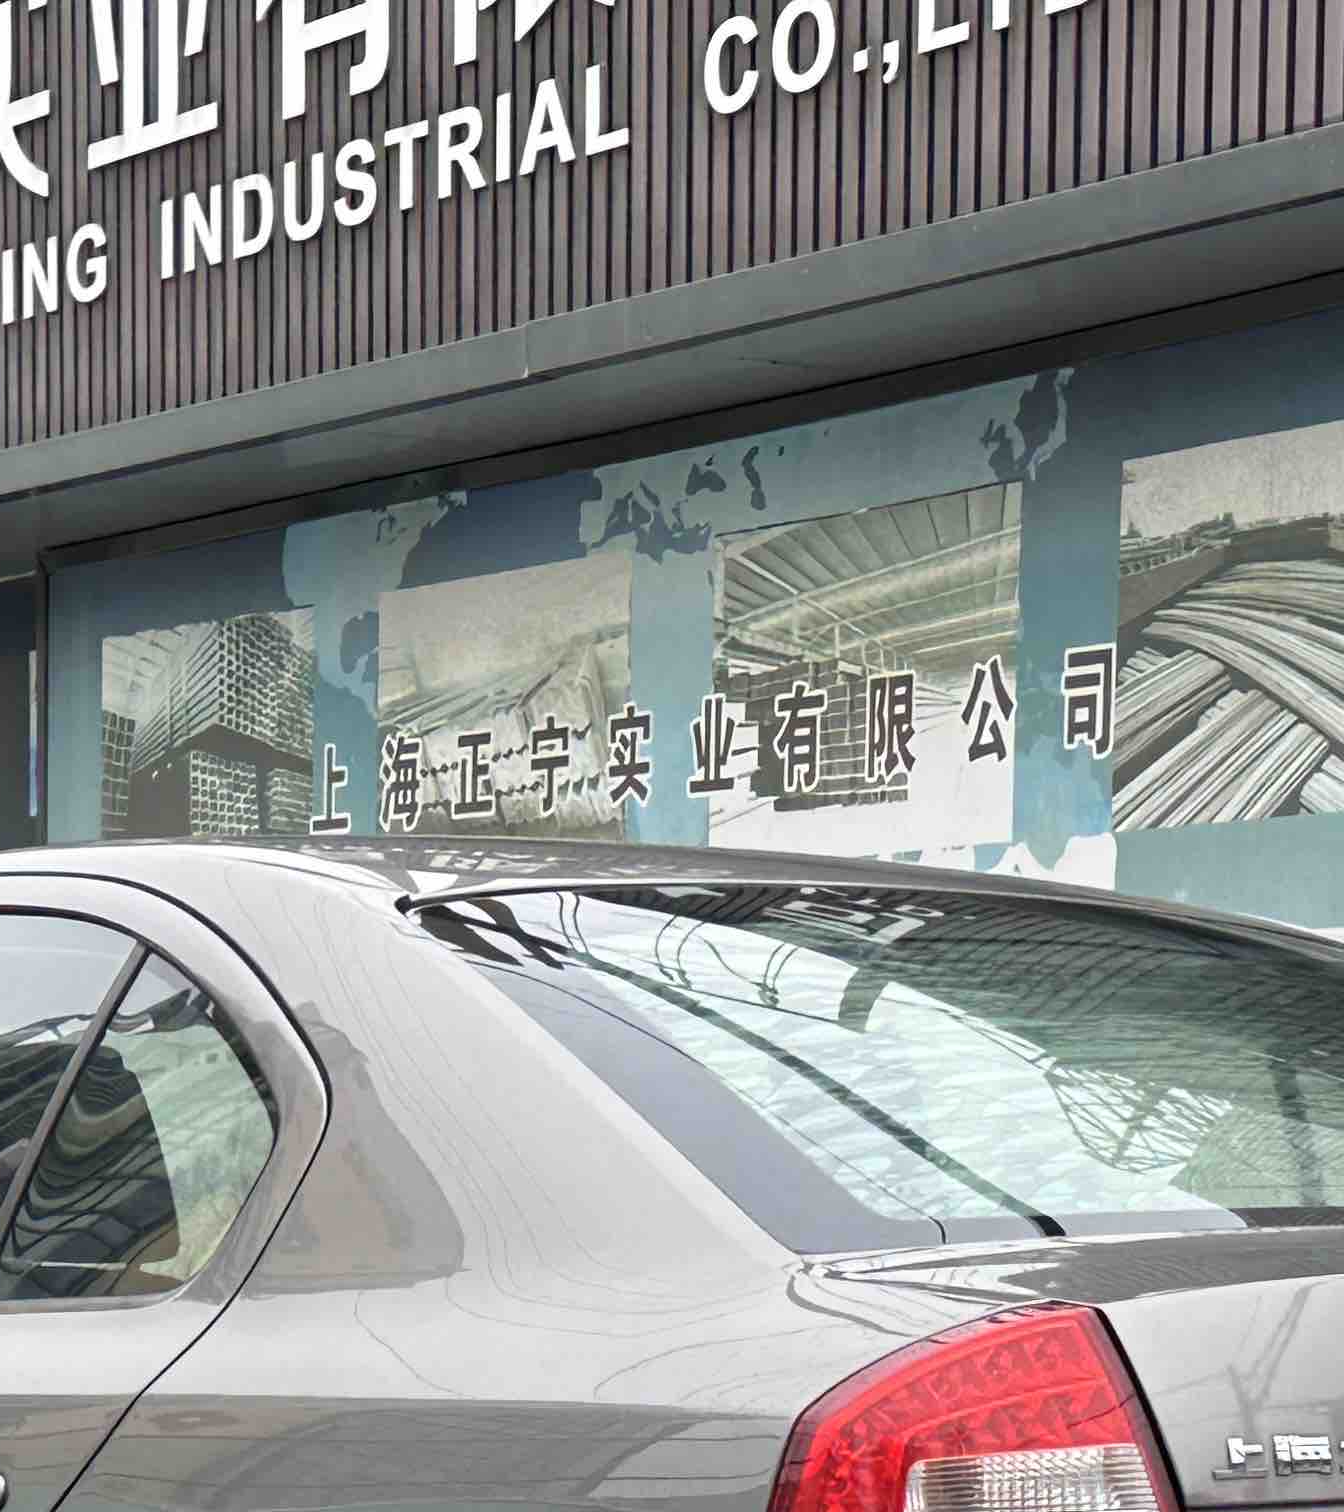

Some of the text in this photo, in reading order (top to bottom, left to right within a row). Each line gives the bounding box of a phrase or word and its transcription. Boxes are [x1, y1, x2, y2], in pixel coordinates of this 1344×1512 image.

[159, 62, 631, 281] INDUSTRIAL
[702, 0, 1089, 115] CO.,L
[311, 644, 1117, 836] 上海正宁实业有限公司
